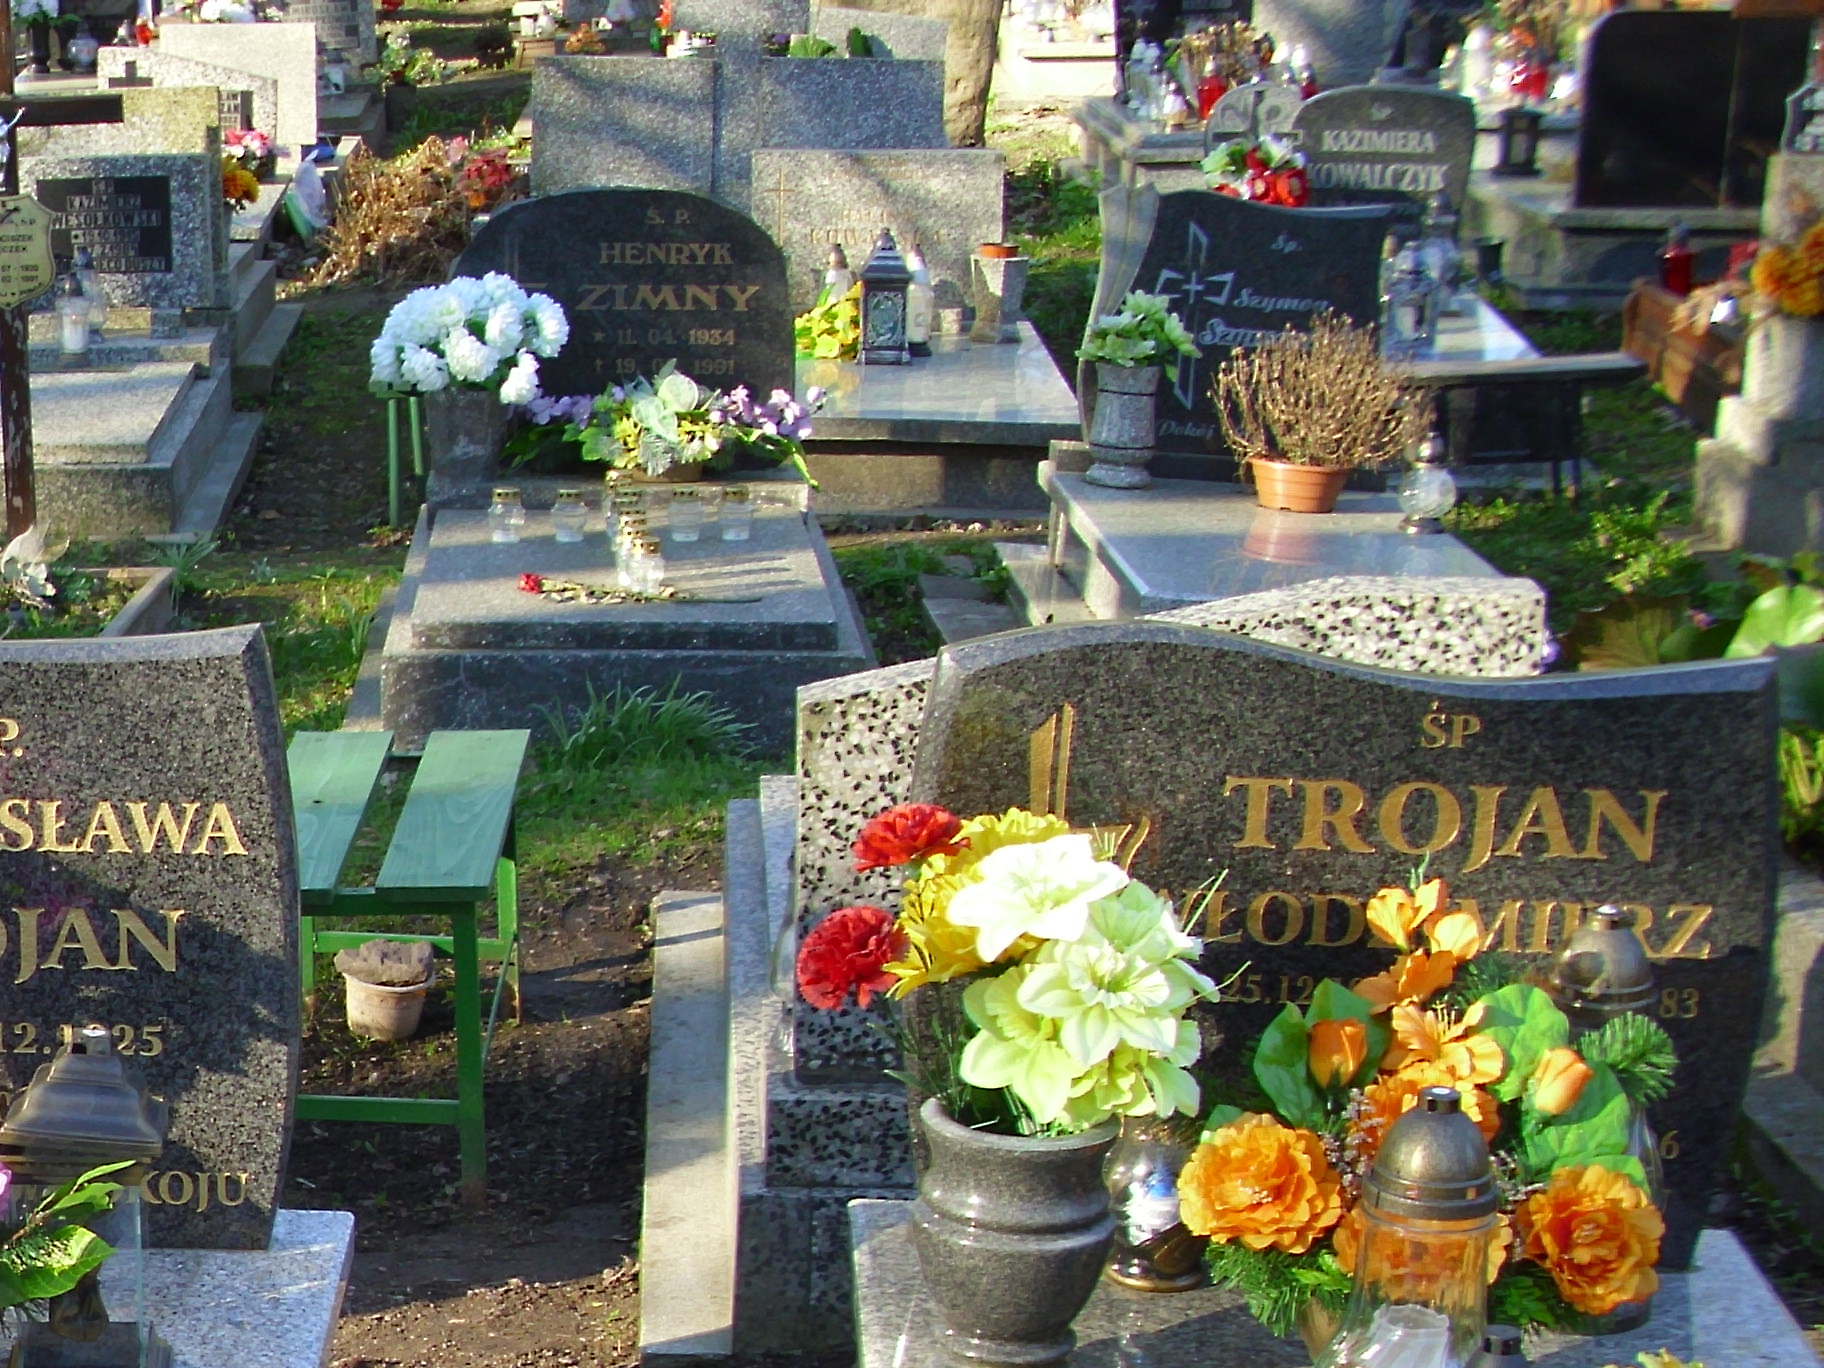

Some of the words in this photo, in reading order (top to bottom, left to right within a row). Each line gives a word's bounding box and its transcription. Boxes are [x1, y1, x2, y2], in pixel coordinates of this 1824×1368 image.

[1321, 129, 1437, 153] KAZIMIERA
[1308, 162, 1450, 193] KOWALCZYK
[598, 241, 734, 266] HENRYK
[575, 284, 761, 312] ZIMNY
[1420, 702, 1483, 750] ŚP
[1224, 775, 1669, 873] TROJAN
